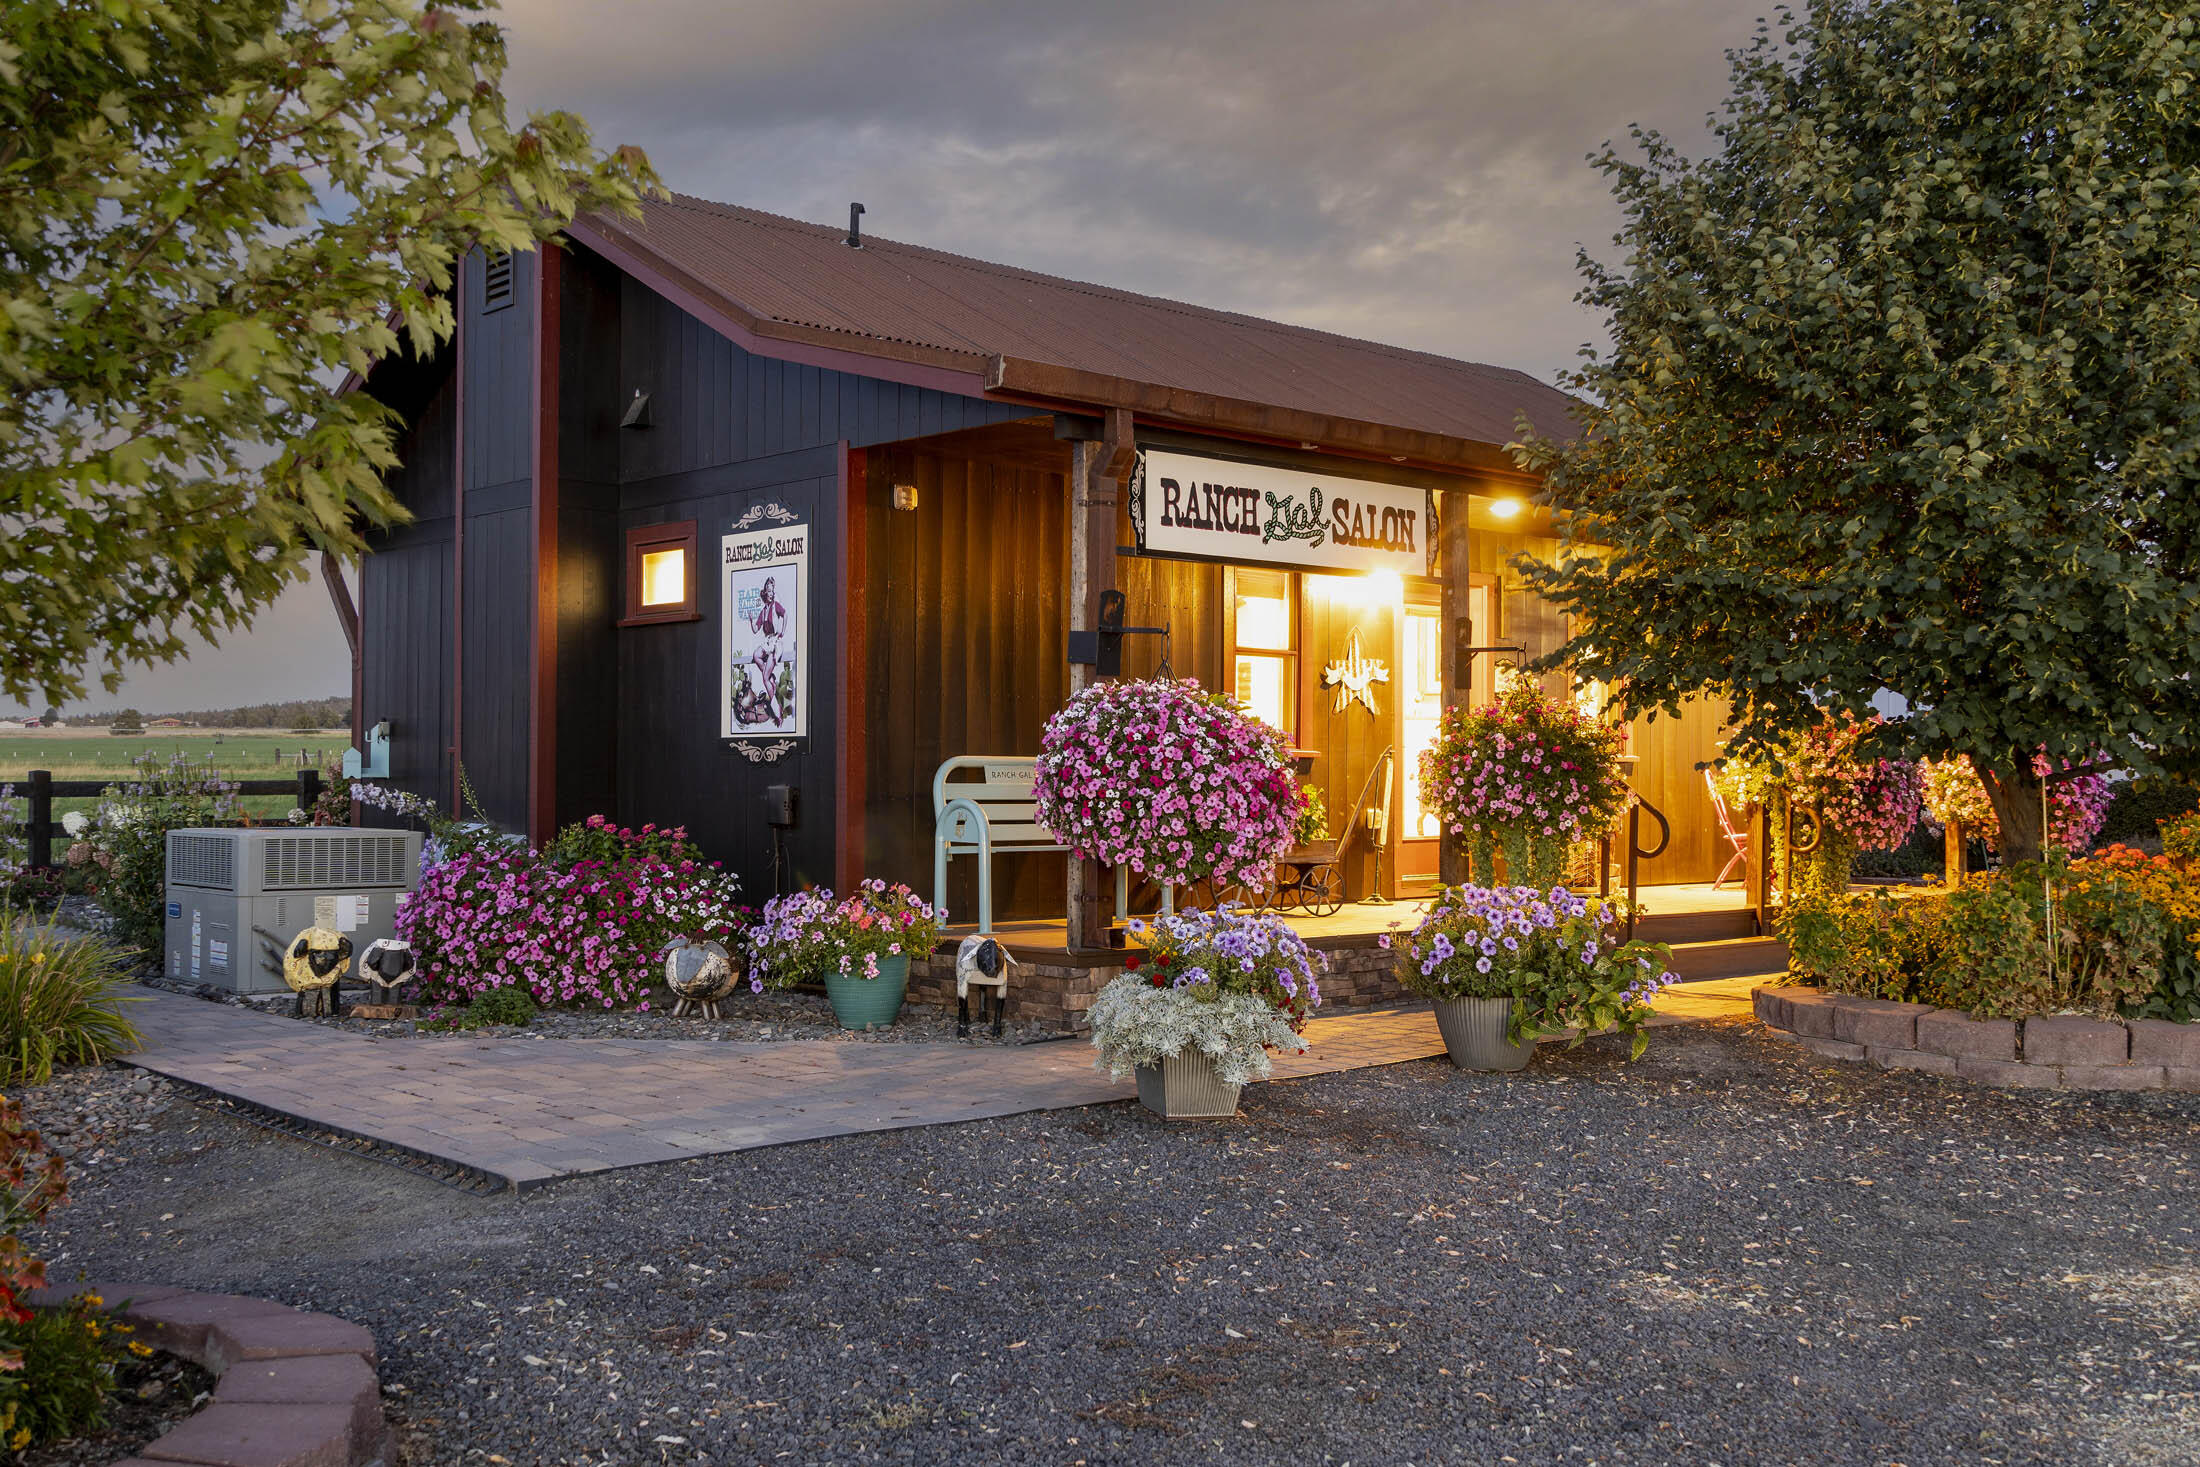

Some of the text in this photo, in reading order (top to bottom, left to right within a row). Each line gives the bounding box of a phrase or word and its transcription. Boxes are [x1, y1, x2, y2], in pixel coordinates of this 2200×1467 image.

[1160, 477, 1417, 553] RANCH Gal SALON
[726, 536, 804, 564] RANCH Gal SALON
[738, 588, 761, 600] HAIR
